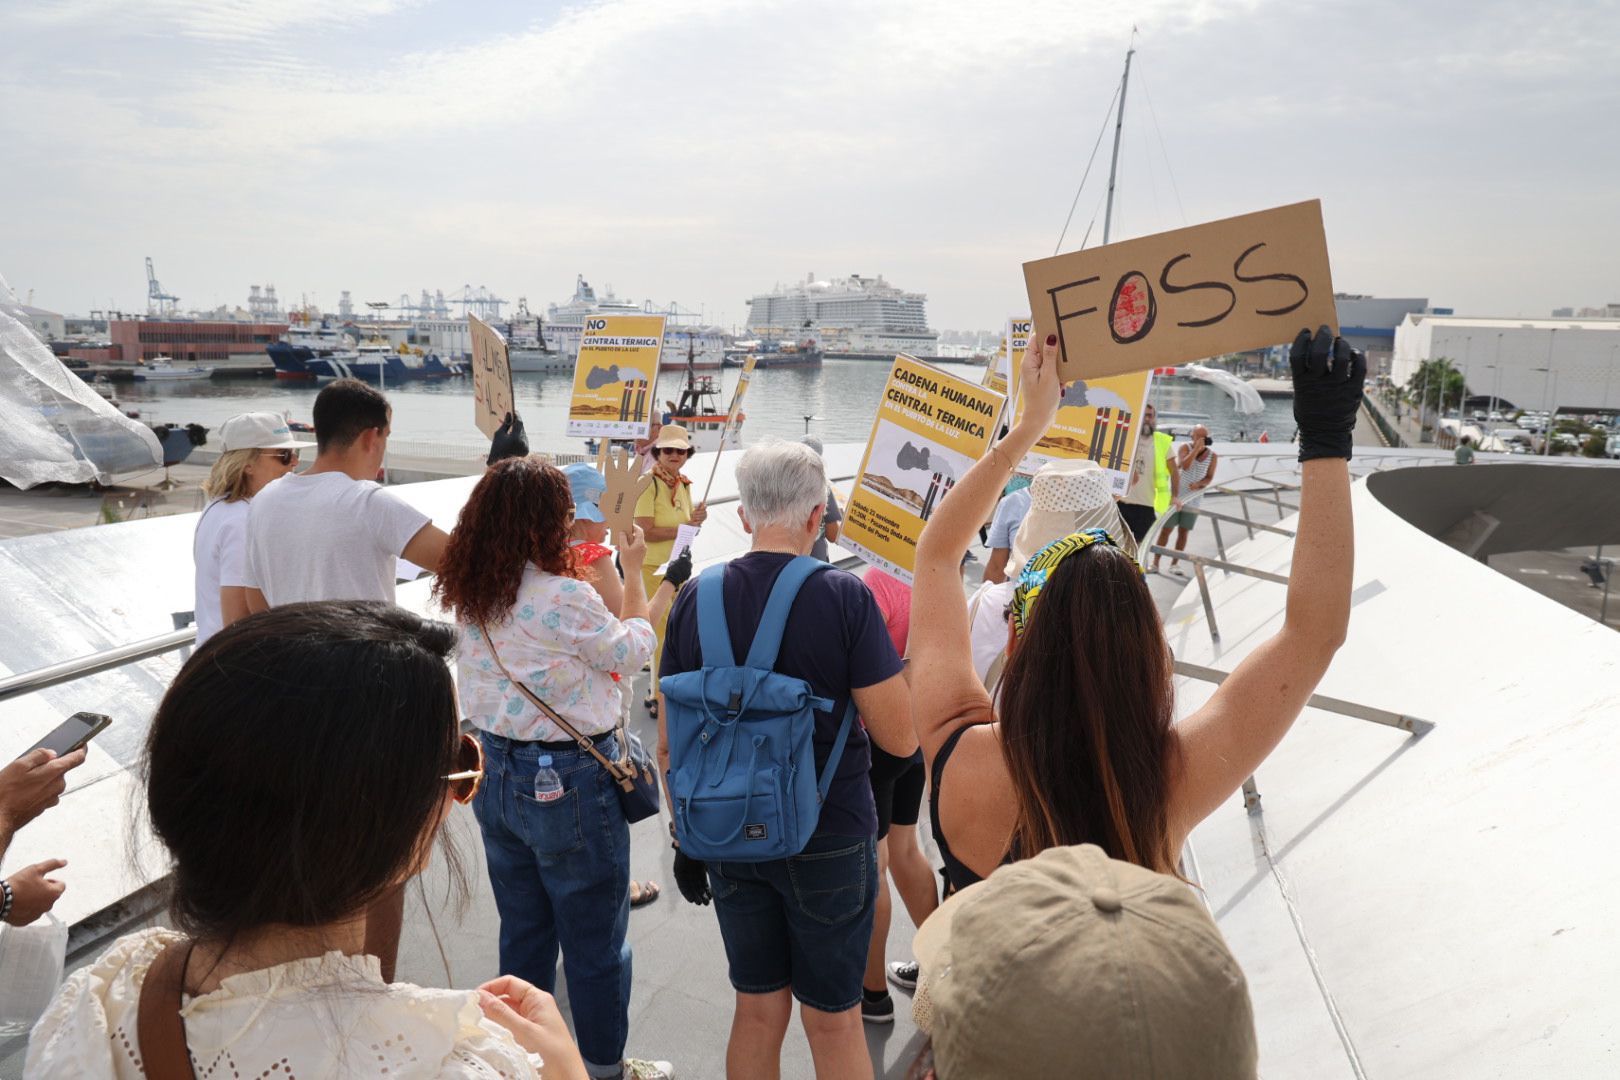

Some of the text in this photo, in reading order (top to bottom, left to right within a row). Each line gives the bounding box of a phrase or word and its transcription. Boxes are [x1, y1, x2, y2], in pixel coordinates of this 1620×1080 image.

[1046, 242, 1309, 363] FOSS
[586, 319, 606, 330] NO
[583, 337, 619, 345] CENTRAL
[887, 388, 933, 417] CENTRAL
[894, 367, 938, 395] CADENA
[940, 385, 993, 418] HUMANA
[902, 407, 926, 423] PUERTO
[926, 418, 935, 428] DE
[935, 422, 945, 432] LA
[945, 427, 960, 439] LUZ
